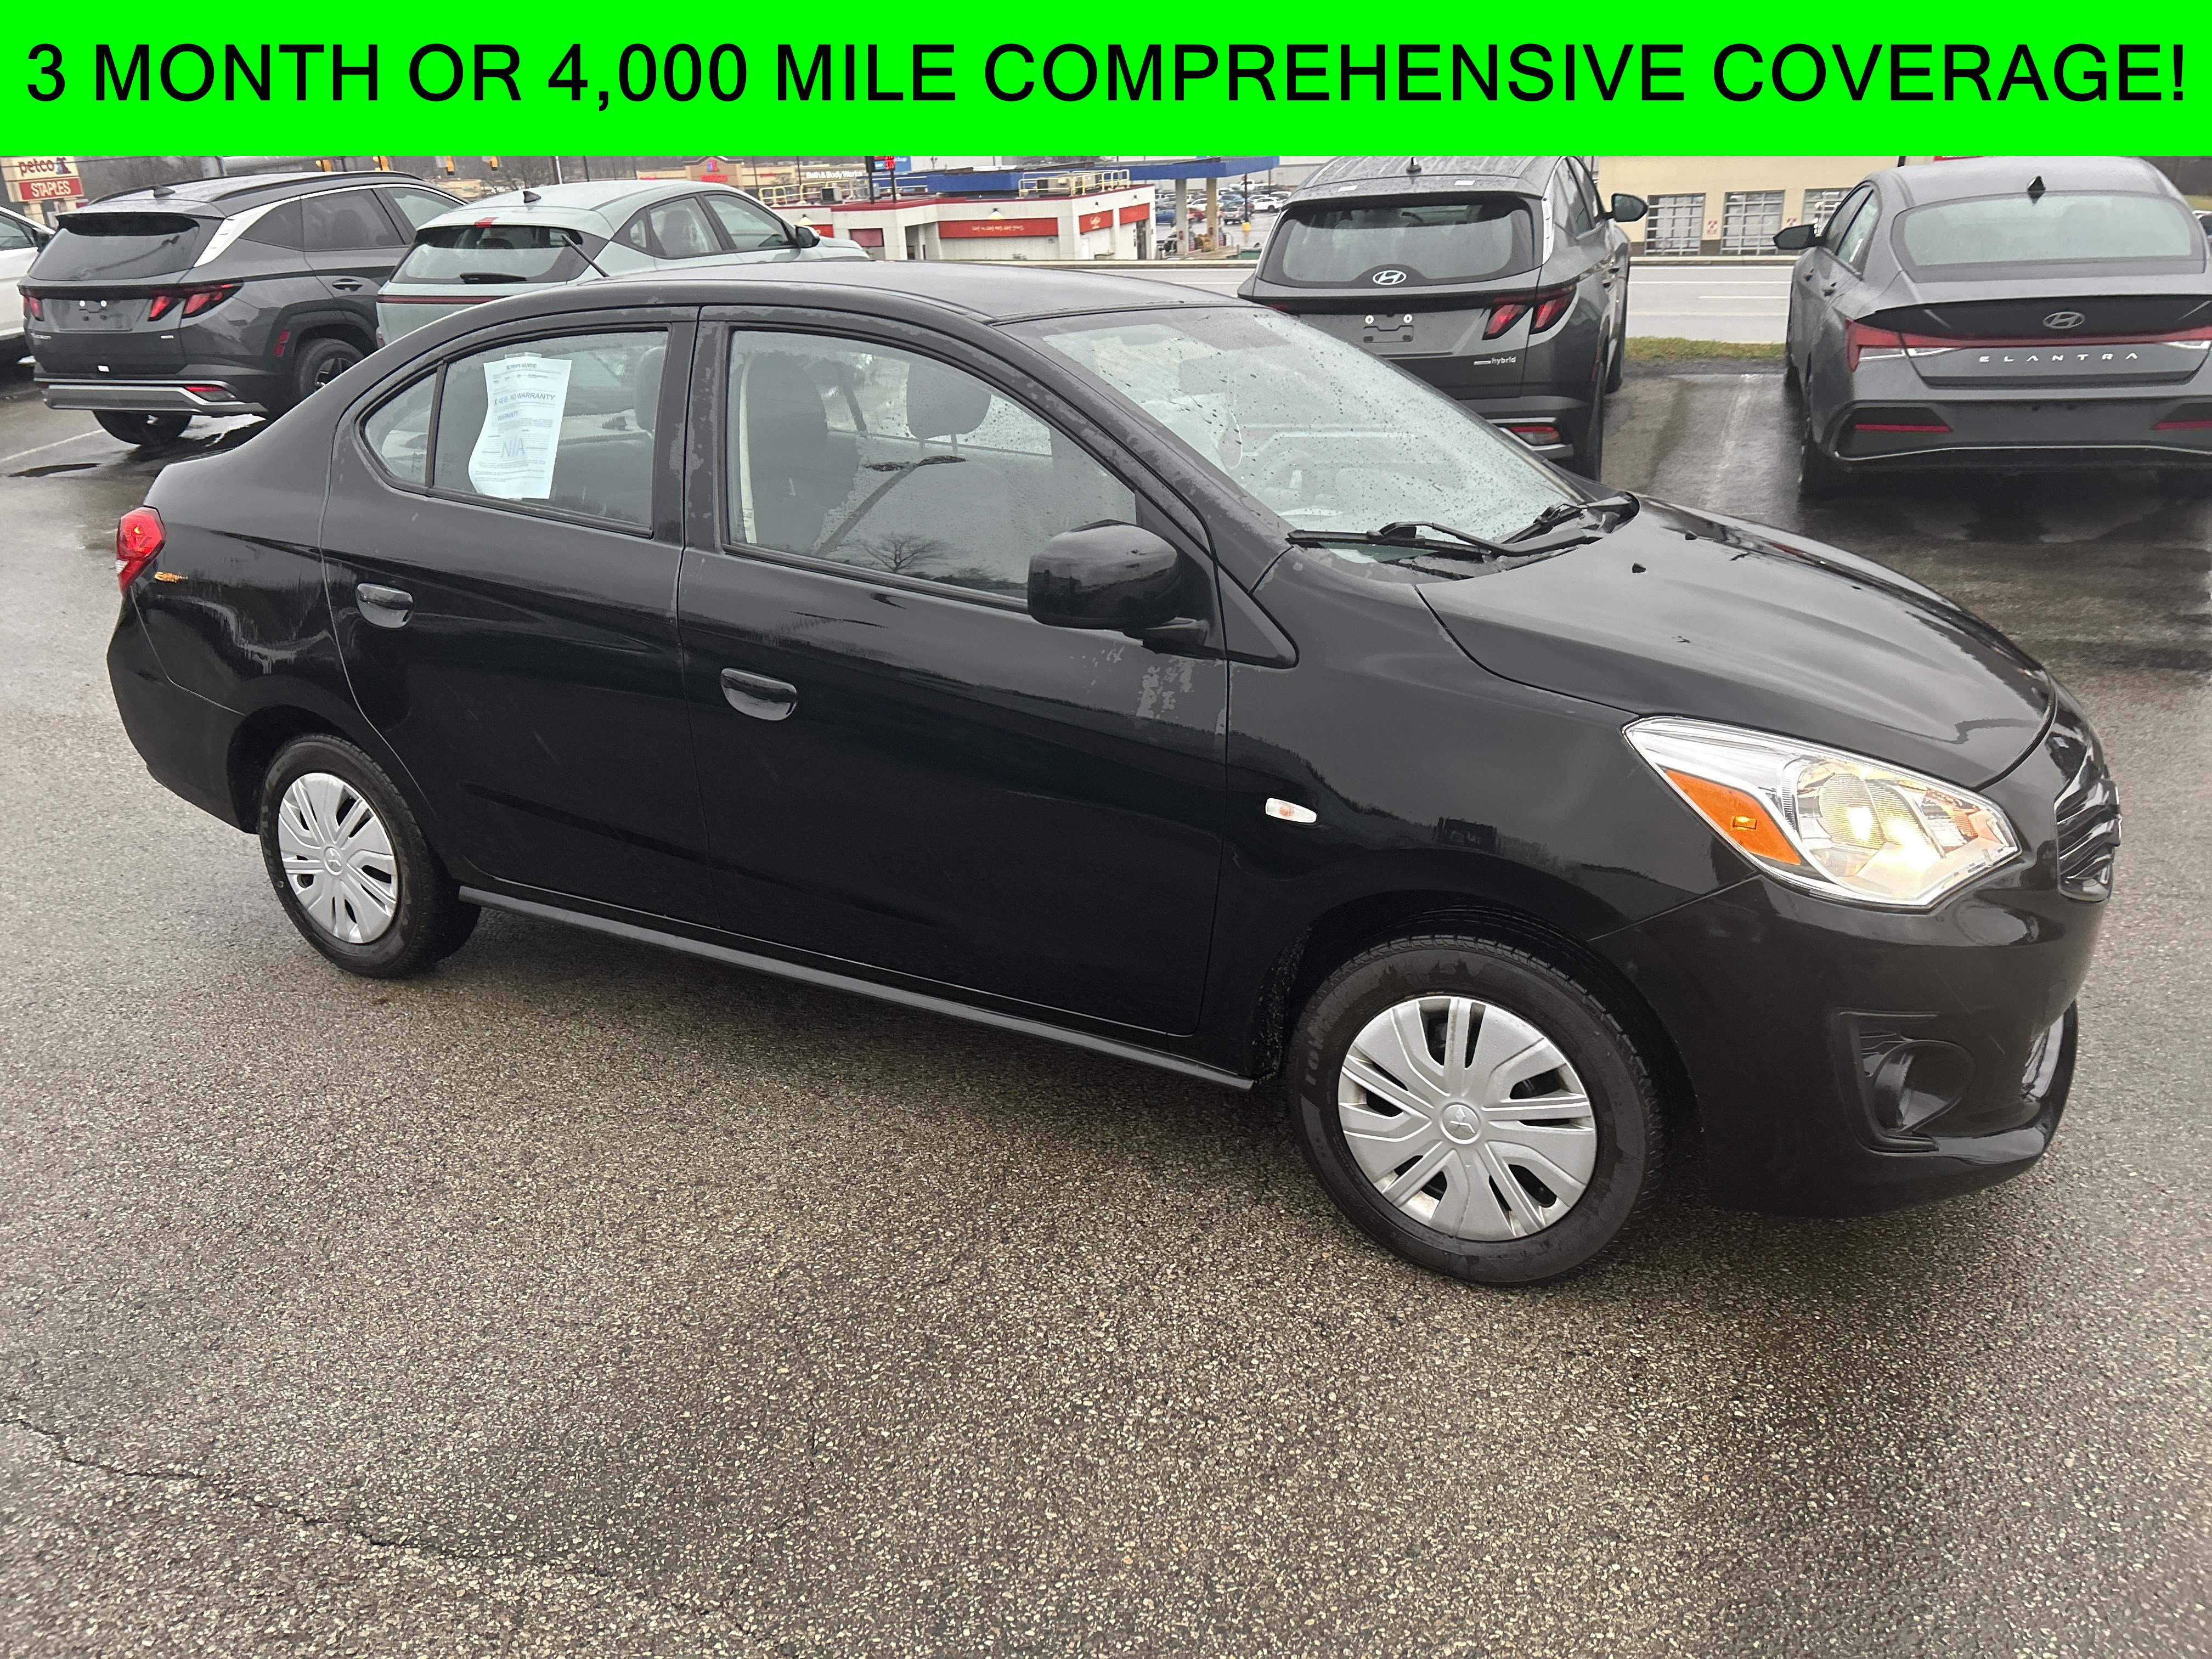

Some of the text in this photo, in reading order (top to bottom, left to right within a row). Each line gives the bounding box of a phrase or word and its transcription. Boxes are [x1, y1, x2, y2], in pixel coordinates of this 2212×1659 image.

[18, 158, 54, 177] petco
[826, 171, 843, 179] Body
[30, 180, 71, 198] STAPLES
[1492, 356, 1516, 365] hybrid
[1979, 352, 2138, 362] ELANTRA
[517, 392, 556, 400] WARRANTY
